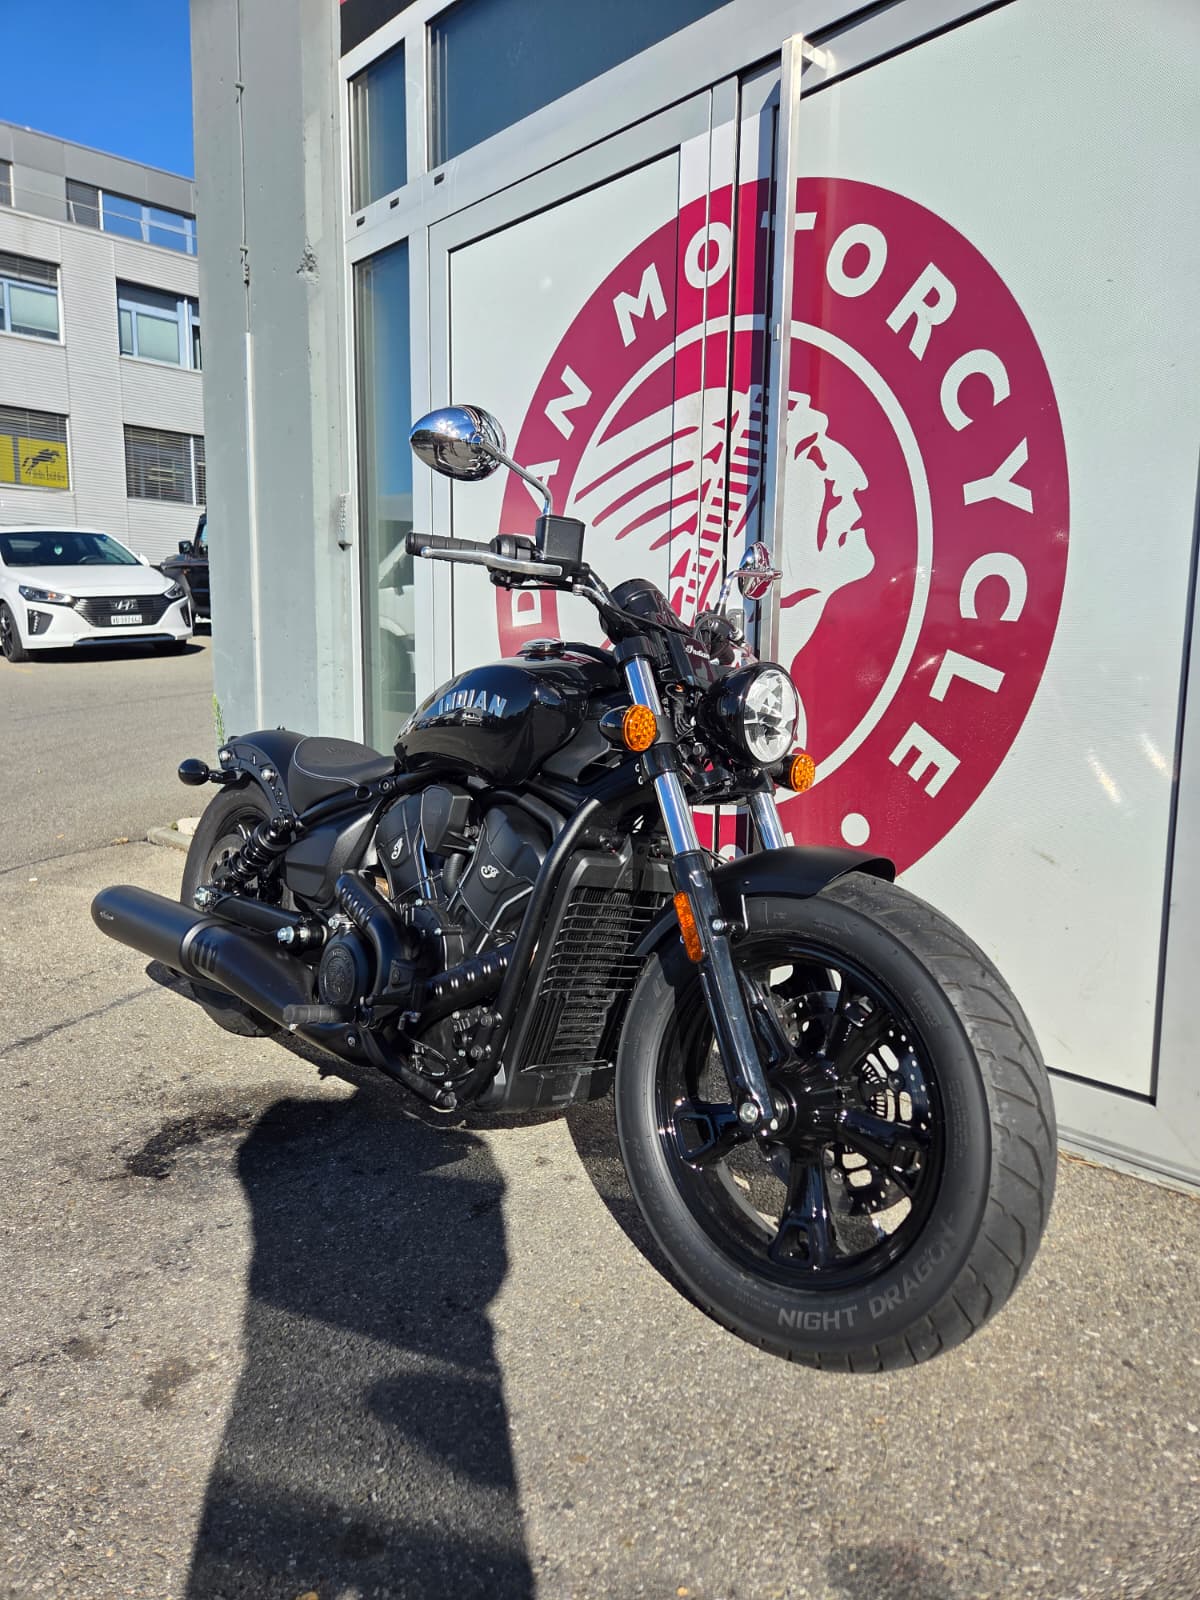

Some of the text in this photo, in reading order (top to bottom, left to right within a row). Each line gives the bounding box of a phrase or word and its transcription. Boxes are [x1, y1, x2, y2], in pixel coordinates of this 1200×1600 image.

[438, 688, 508, 718] INDIAN
[777, 1220, 958, 1331] NIGHT DRAGON
